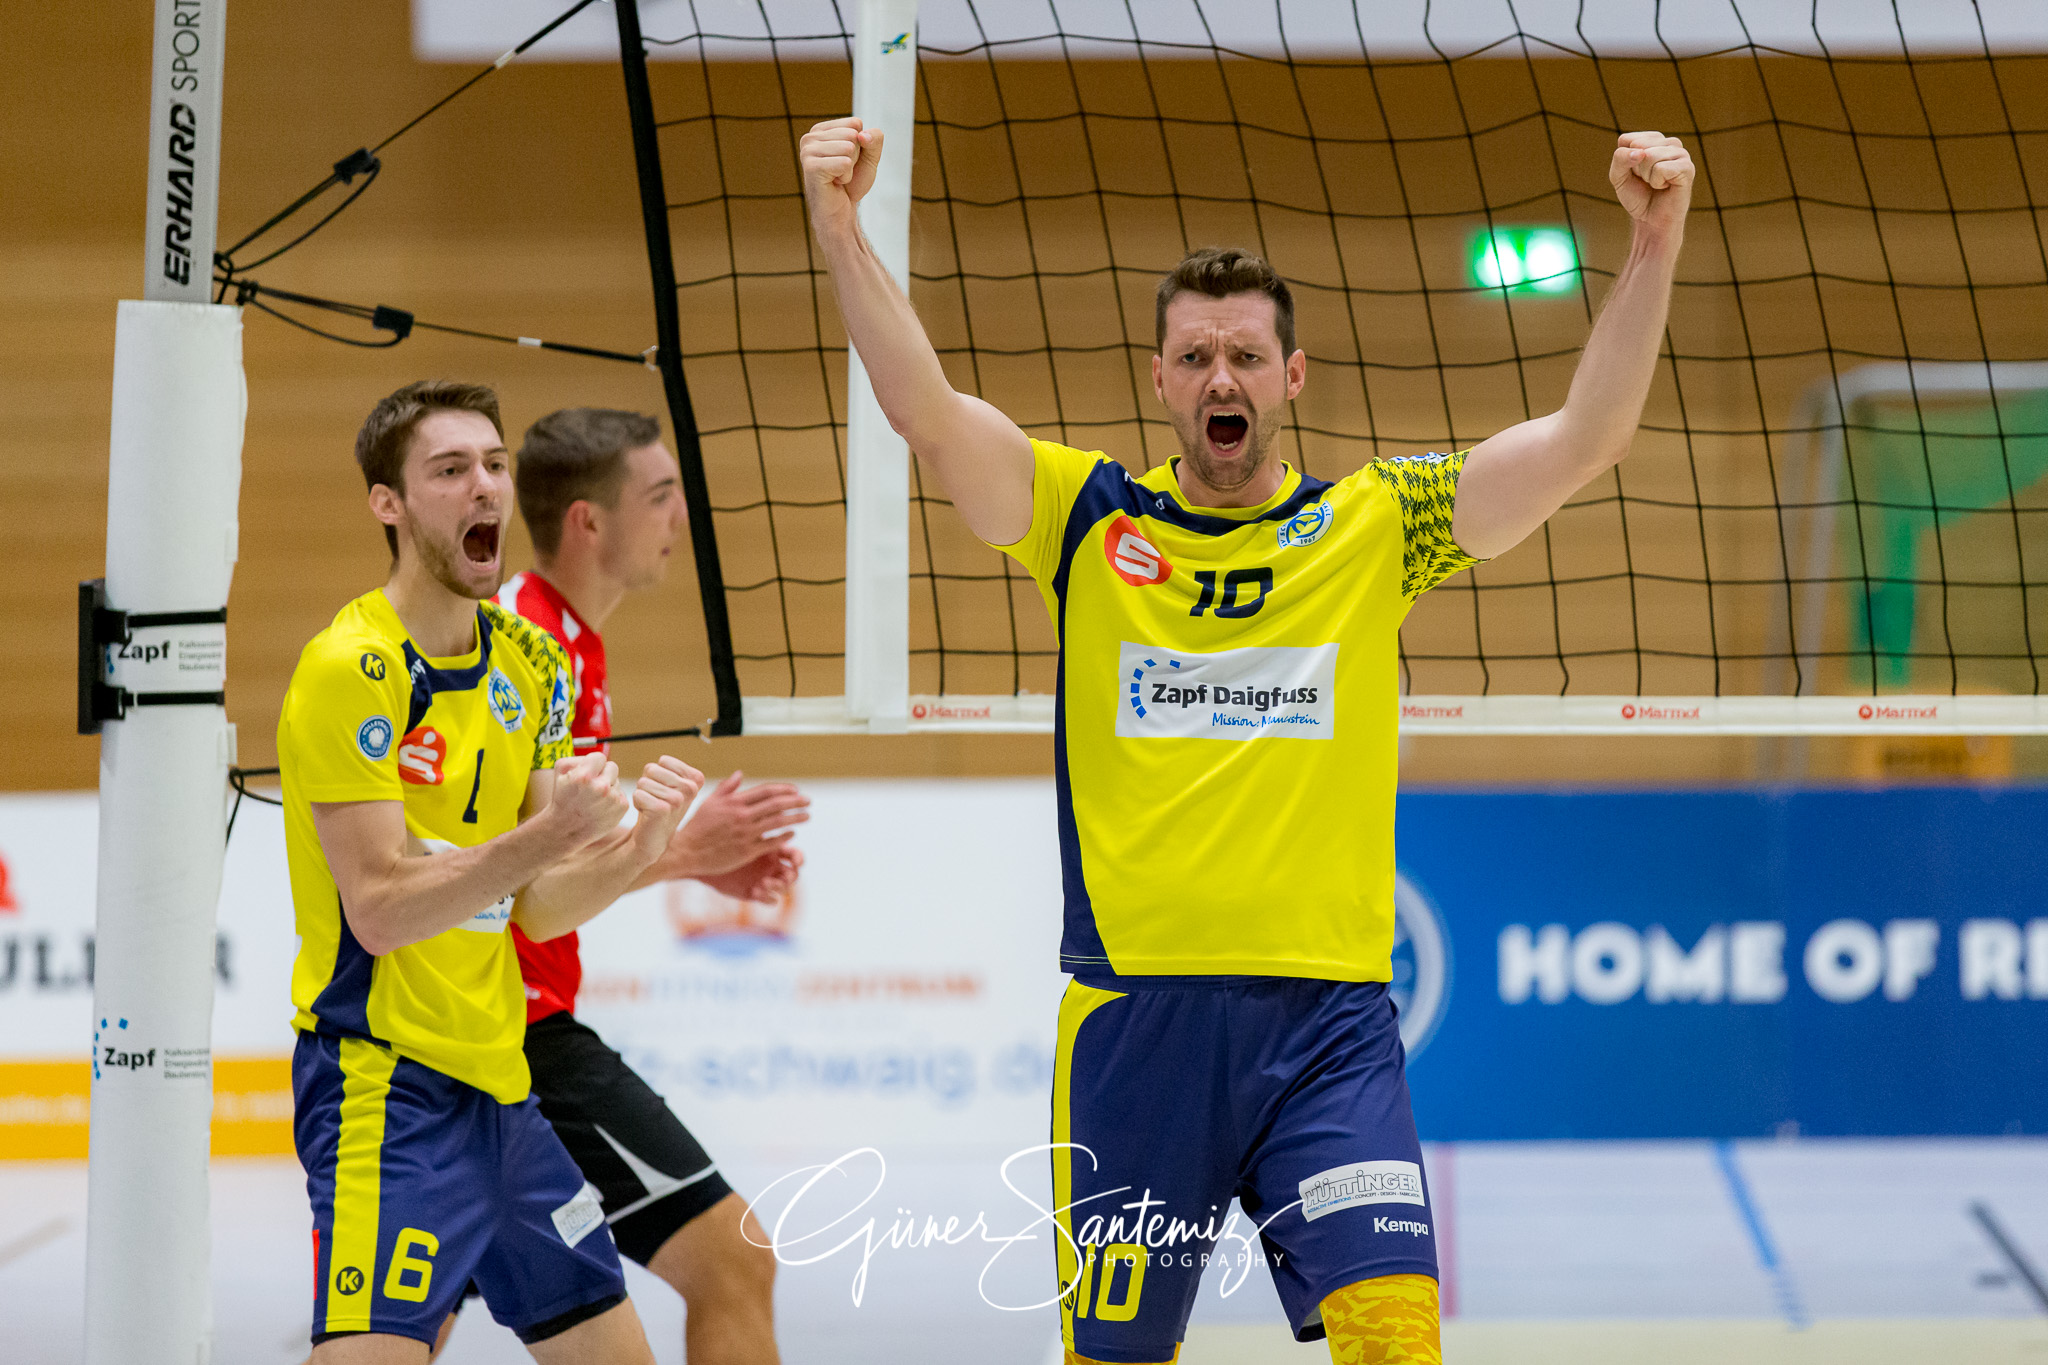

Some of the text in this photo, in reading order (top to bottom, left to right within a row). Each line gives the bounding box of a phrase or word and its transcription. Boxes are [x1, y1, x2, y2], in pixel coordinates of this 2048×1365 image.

[164, 0, 201, 287] ERHARD SPORT
[1189, 567, 1273, 618] 10
[118, 639, 170, 663] Zapf
[1151, 683, 1318, 712] Zapf Daigfuss
[929, 705, 990, 719] Marmot
[1402, 705, 1463, 718] Marmot
[1639, 705, 1700, 719] Marmot
[1876, 705, 1937, 719] Marmot
[1499, 921, 1787, 1003] HOME
[1804, 917, 1941, 1002] OF
[104, 1046, 155, 1070] Zapf
[1374, 1217, 1428, 1237] Kempa
[383, 1227, 439, 1303] 6
[1077, 1242, 1147, 1322] 10
